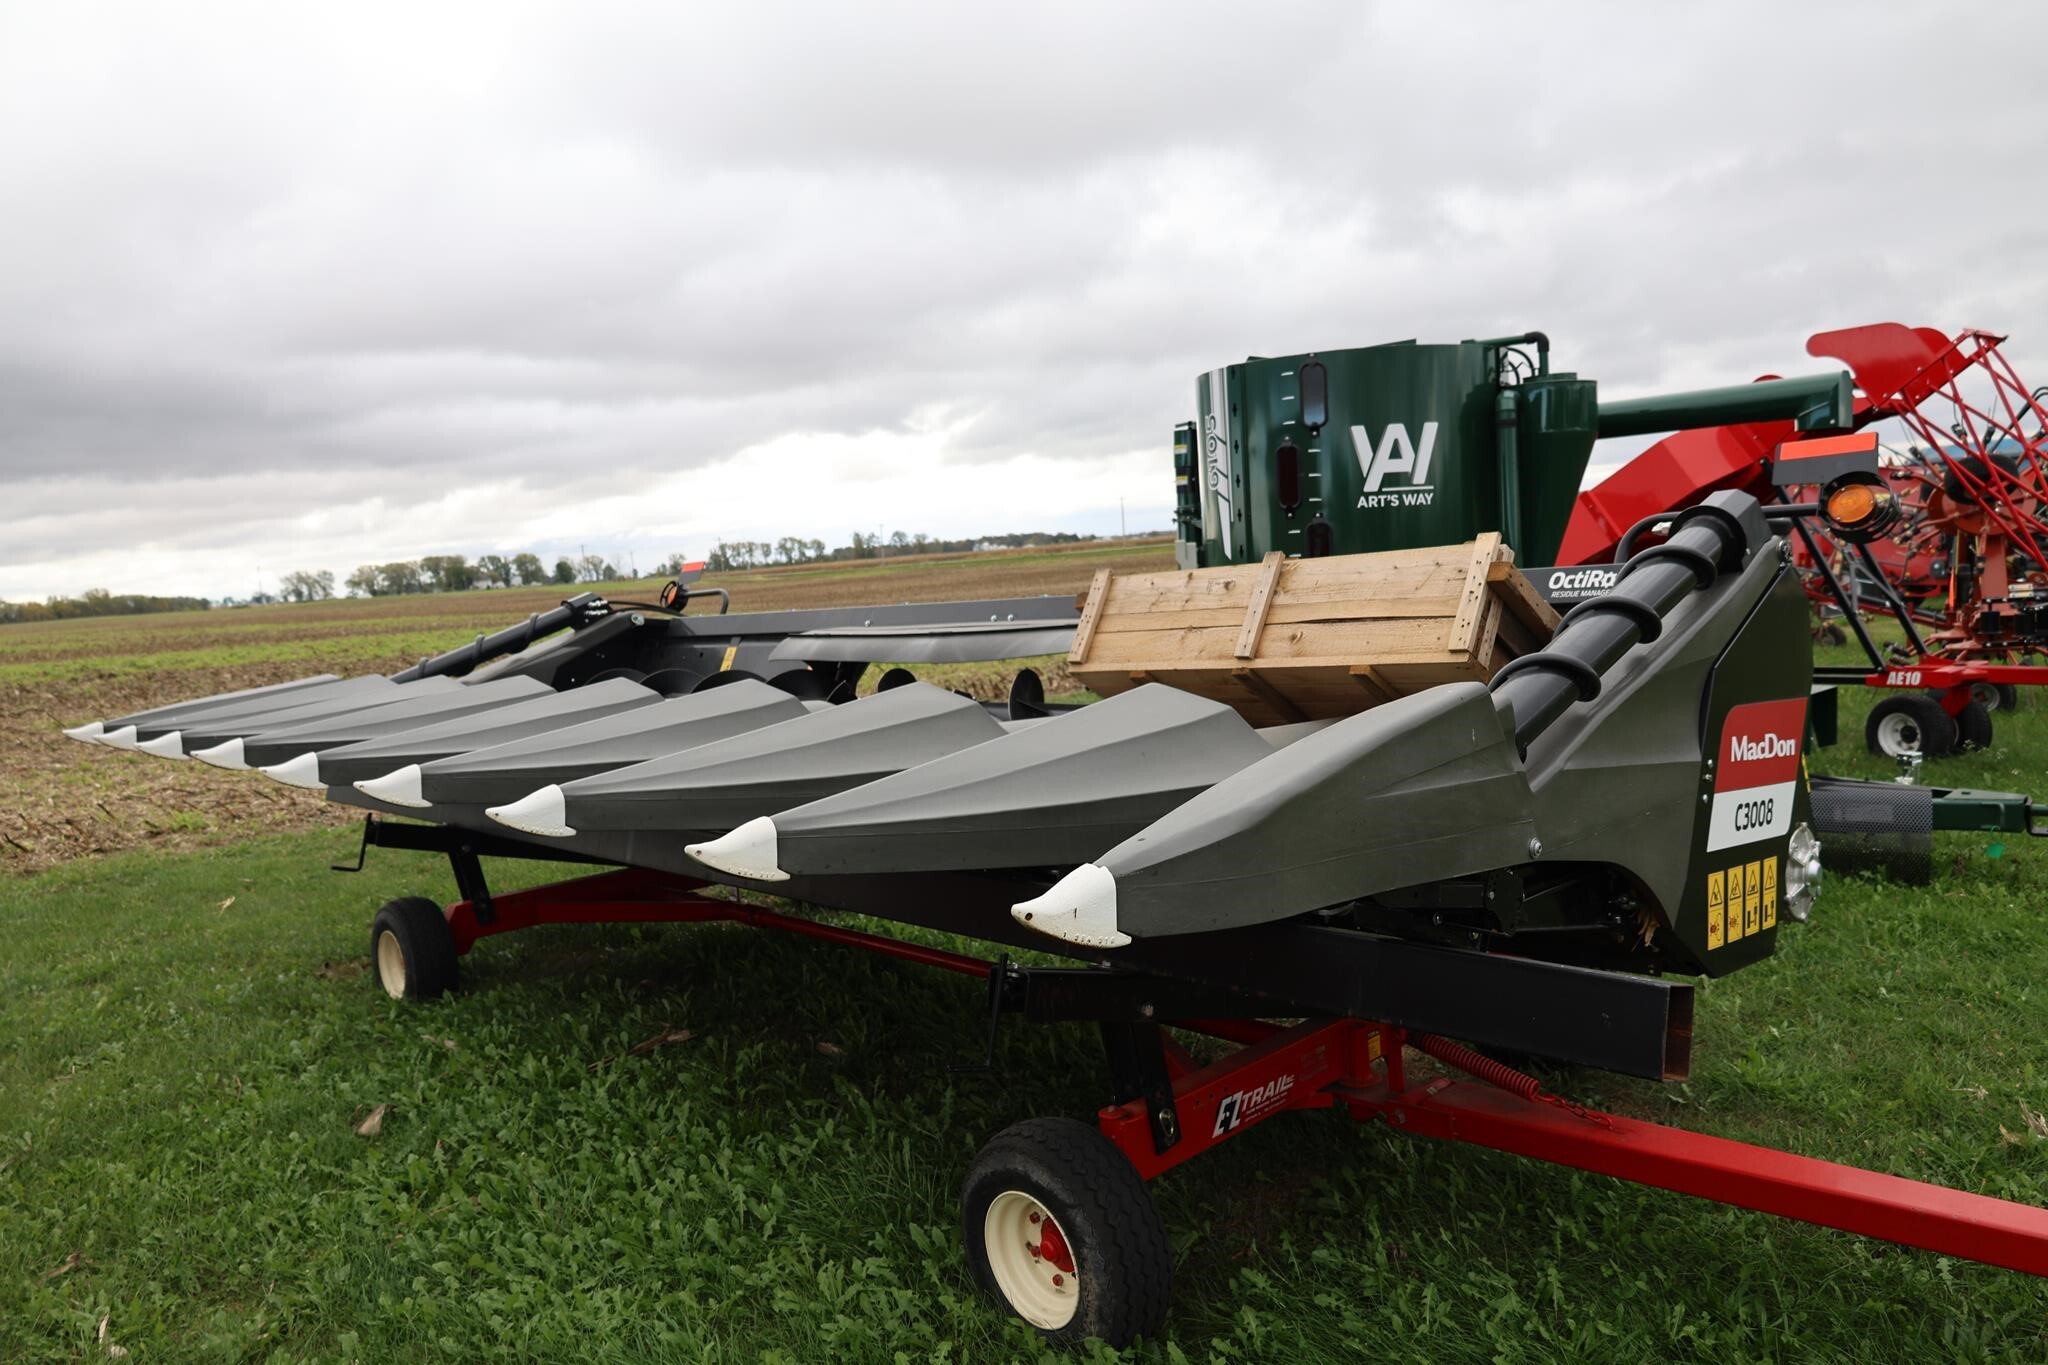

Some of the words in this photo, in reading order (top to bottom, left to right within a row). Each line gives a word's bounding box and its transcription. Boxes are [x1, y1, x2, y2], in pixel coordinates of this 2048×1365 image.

[1357, 494, 1400, 508] ART'S
[1402, 492, 1434, 506] WAY
[1551, 590, 1580, 598] RESIDUE
[1886, 671, 1922, 686] AE10
[1731, 733, 1796, 762] MacDon
[1735, 798, 1774, 832] C3008
[1241, 1074, 1294, 1113] TRAIL
